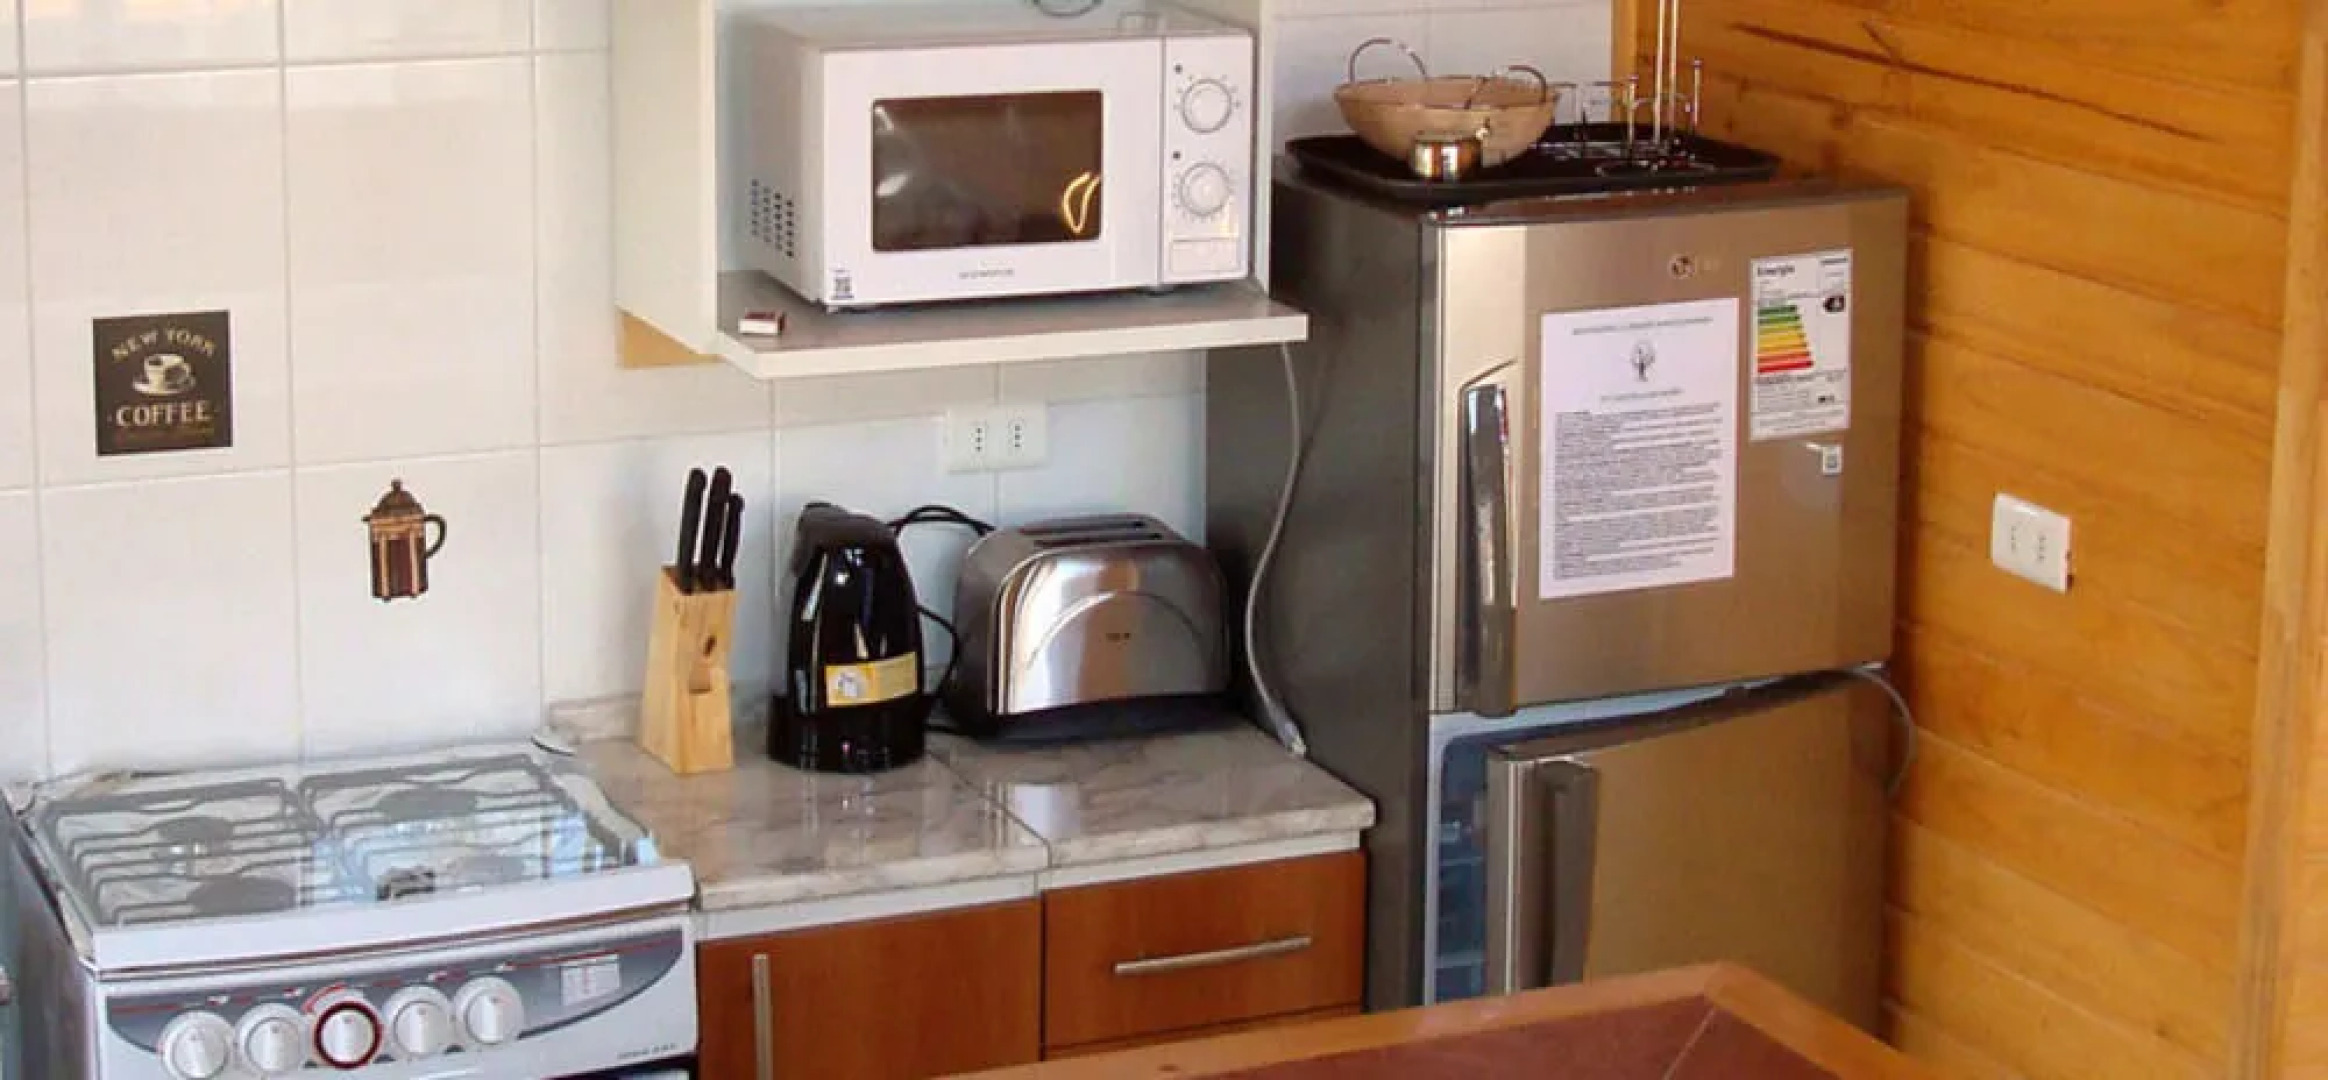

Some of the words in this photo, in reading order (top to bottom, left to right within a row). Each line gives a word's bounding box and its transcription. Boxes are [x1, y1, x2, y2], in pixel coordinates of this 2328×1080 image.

[112, 330, 158, 362] NEW
[165, 328, 216, 357] YORK
[115, 401, 213, 427] COFFEE
